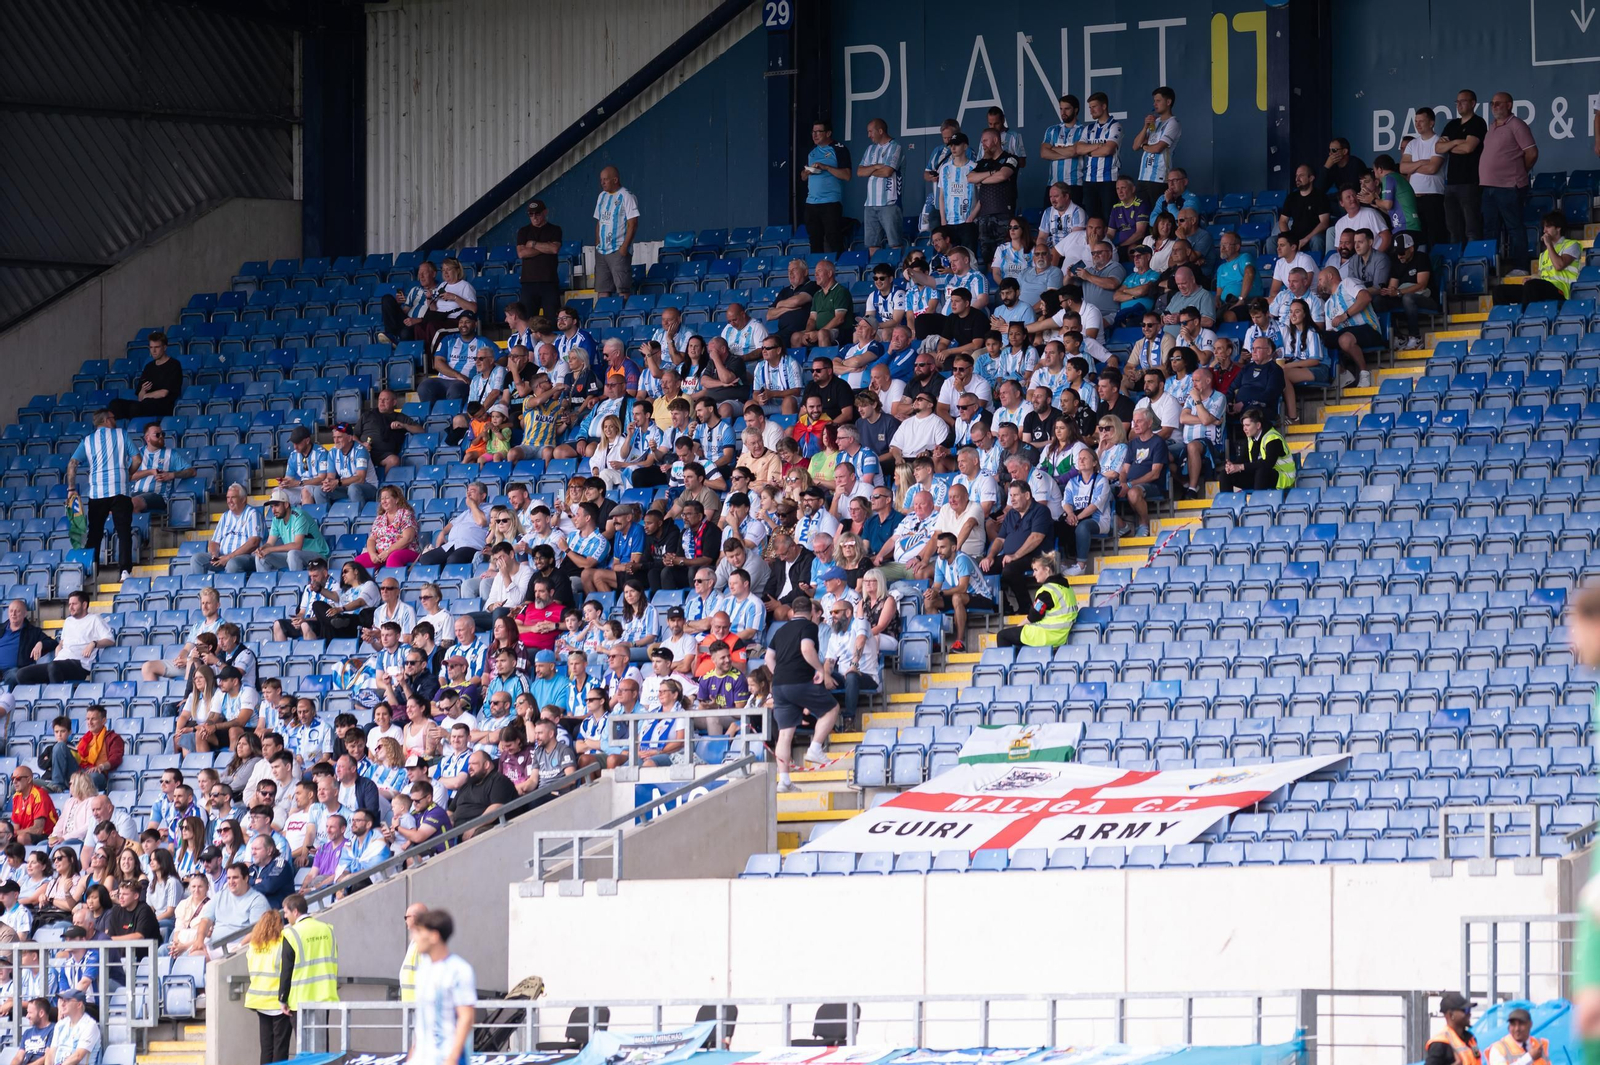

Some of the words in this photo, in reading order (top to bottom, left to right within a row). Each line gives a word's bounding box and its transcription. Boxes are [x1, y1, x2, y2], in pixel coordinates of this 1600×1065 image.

[765, 1, 790, 26] 29
[843, 17, 1187, 141] PLANET
[944, 797, 1107, 815] MALAGA
[868, 819, 974, 839] GUIRI
[1059, 820, 1182, 841] ARMY
